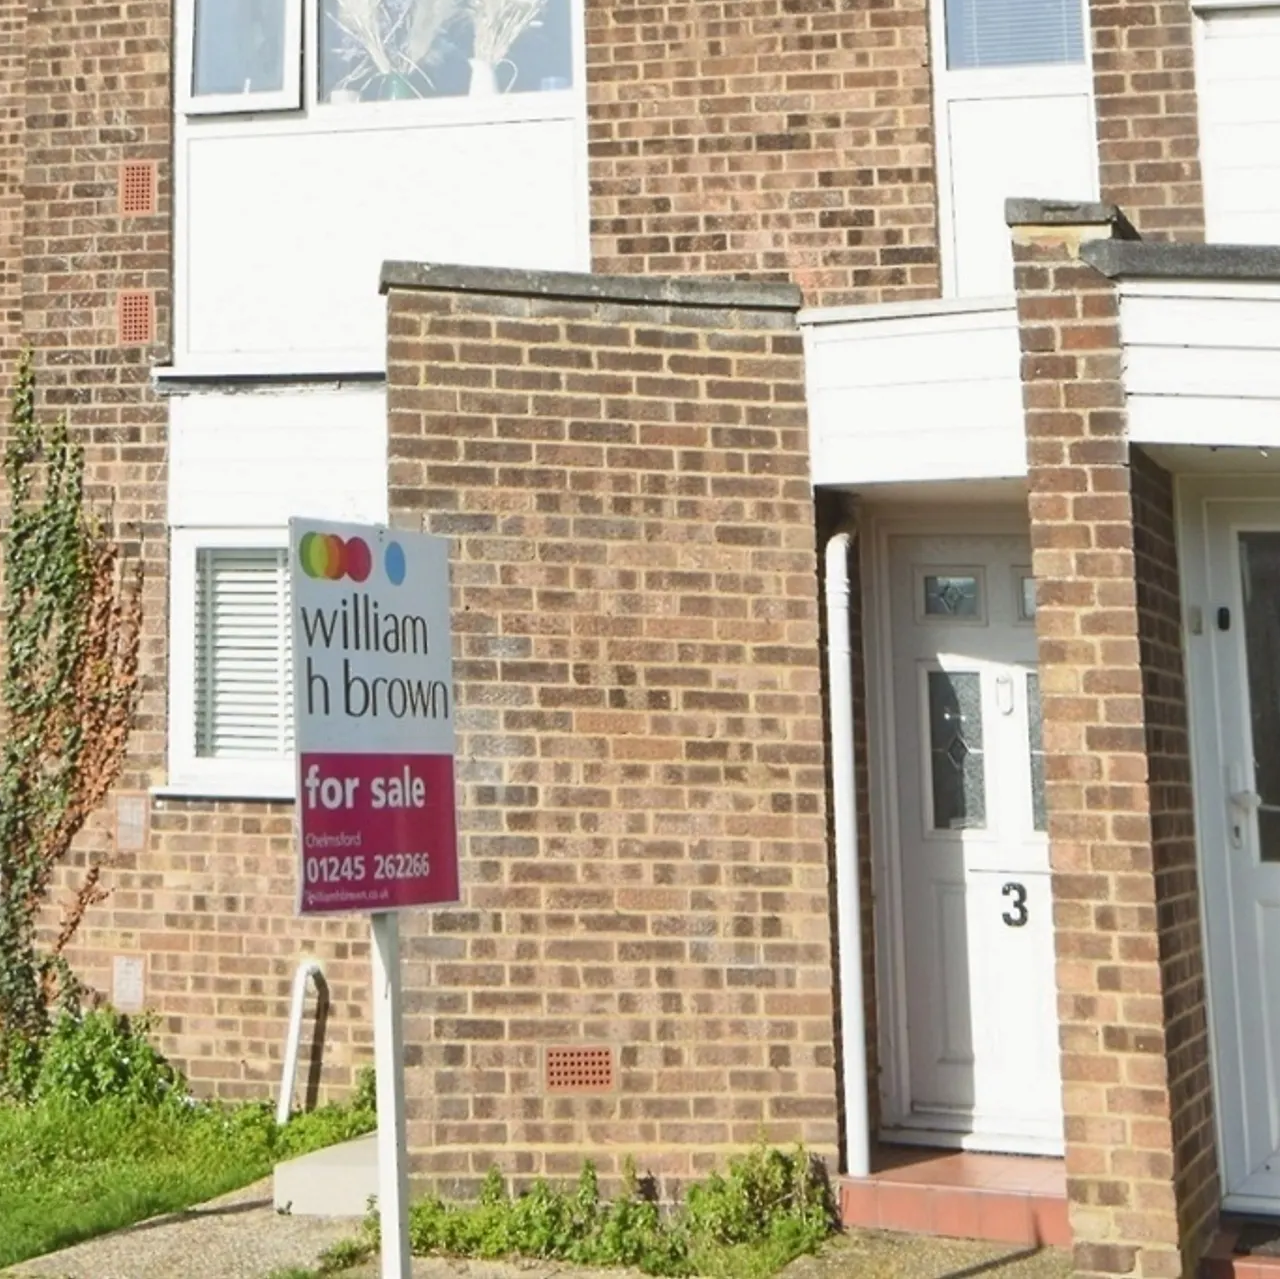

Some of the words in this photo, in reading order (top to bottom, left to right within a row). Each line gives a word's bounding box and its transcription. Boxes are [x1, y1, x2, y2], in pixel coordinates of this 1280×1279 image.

[301, 593, 429, 655] william
[306, 656, 331, 715] h
[344, 658, 449, 719] brown
[305, 764, 360, 809] for
[370, 764, 426, 809] sale
[305, 830, 362, 848] Chelmsford
[306, 855, 366, 883] 01245
[373, 852, 430, 880] 262266
[1002, 882, 1028, 927] 3
